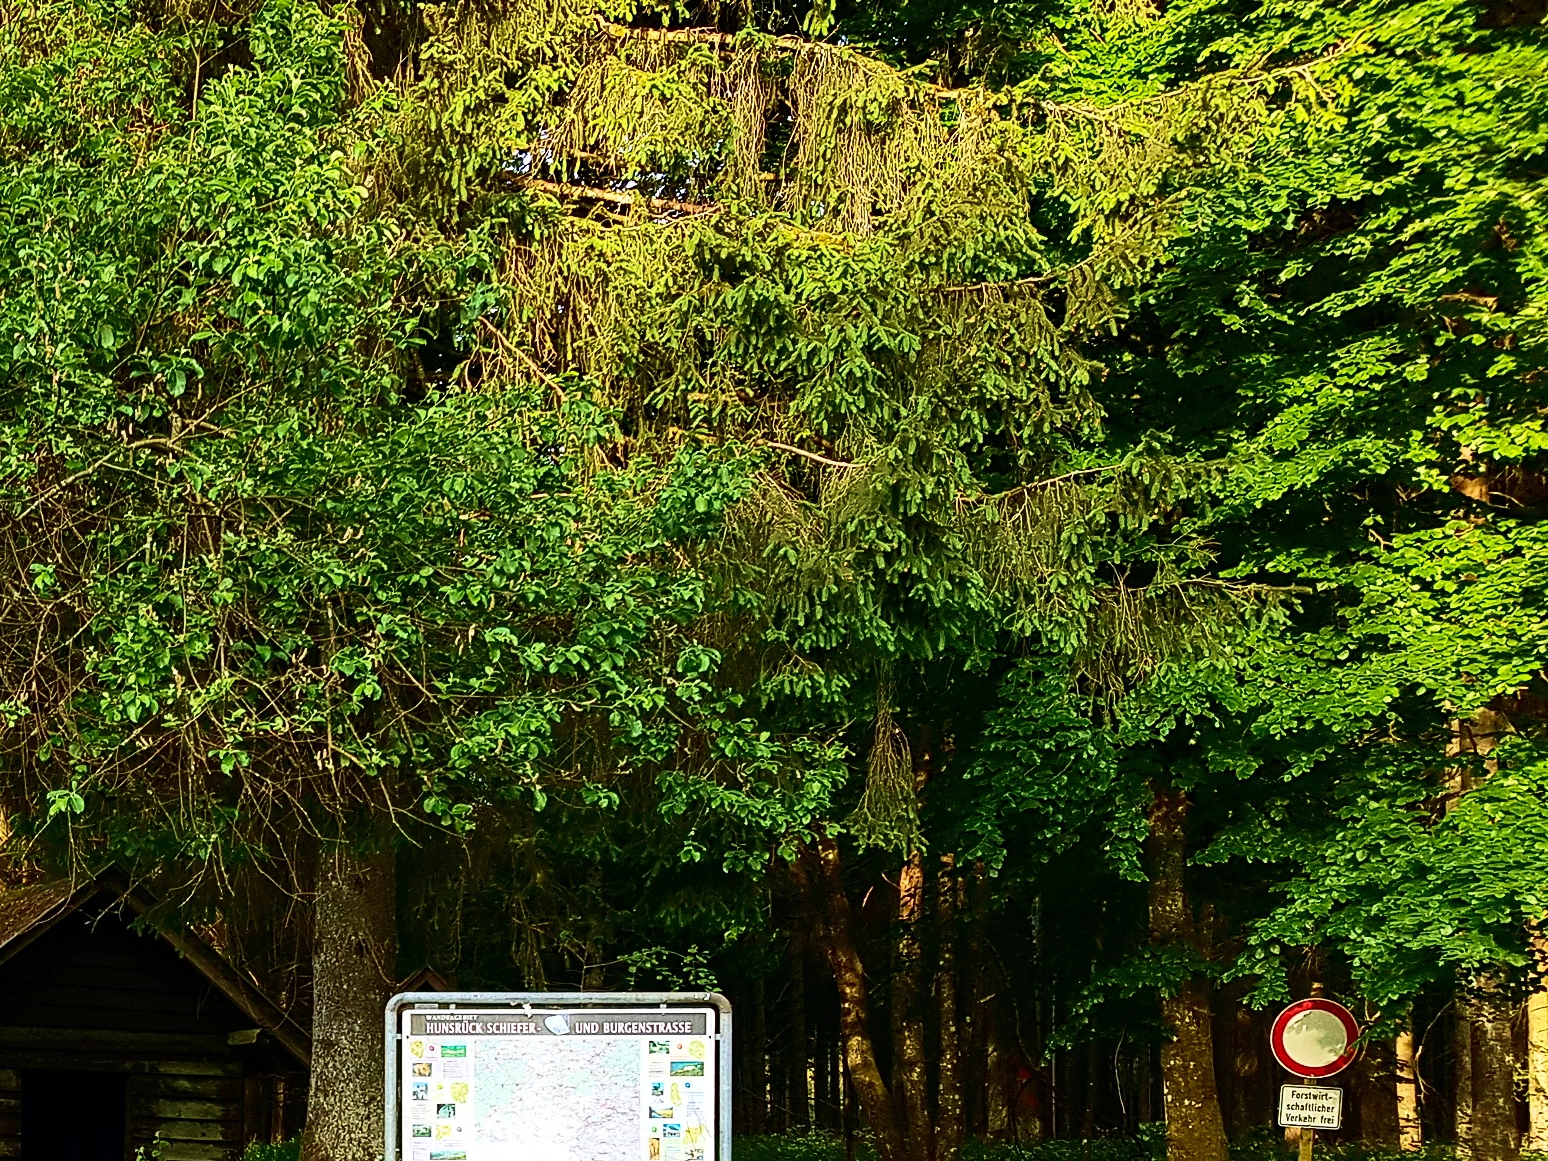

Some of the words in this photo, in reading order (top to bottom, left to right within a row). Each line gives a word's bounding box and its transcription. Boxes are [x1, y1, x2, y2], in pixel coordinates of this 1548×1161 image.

[426, 1020, 484, 1034] HUNSRÜCK
[486, 1021, 542, 1034] SCHIEFER-
[575, 1022, 599, 1034] UND
[603, 1021, 692, 1034] BURGENSTRASSE
[1291, 1090, 1333, 1101] Forstwirt-
[1286, 1102, 1335, 1113] schaftlicher
[1285, 1113, 1317, 1123] Verkehr
[1320, 1115, 1335, 1125] frei
